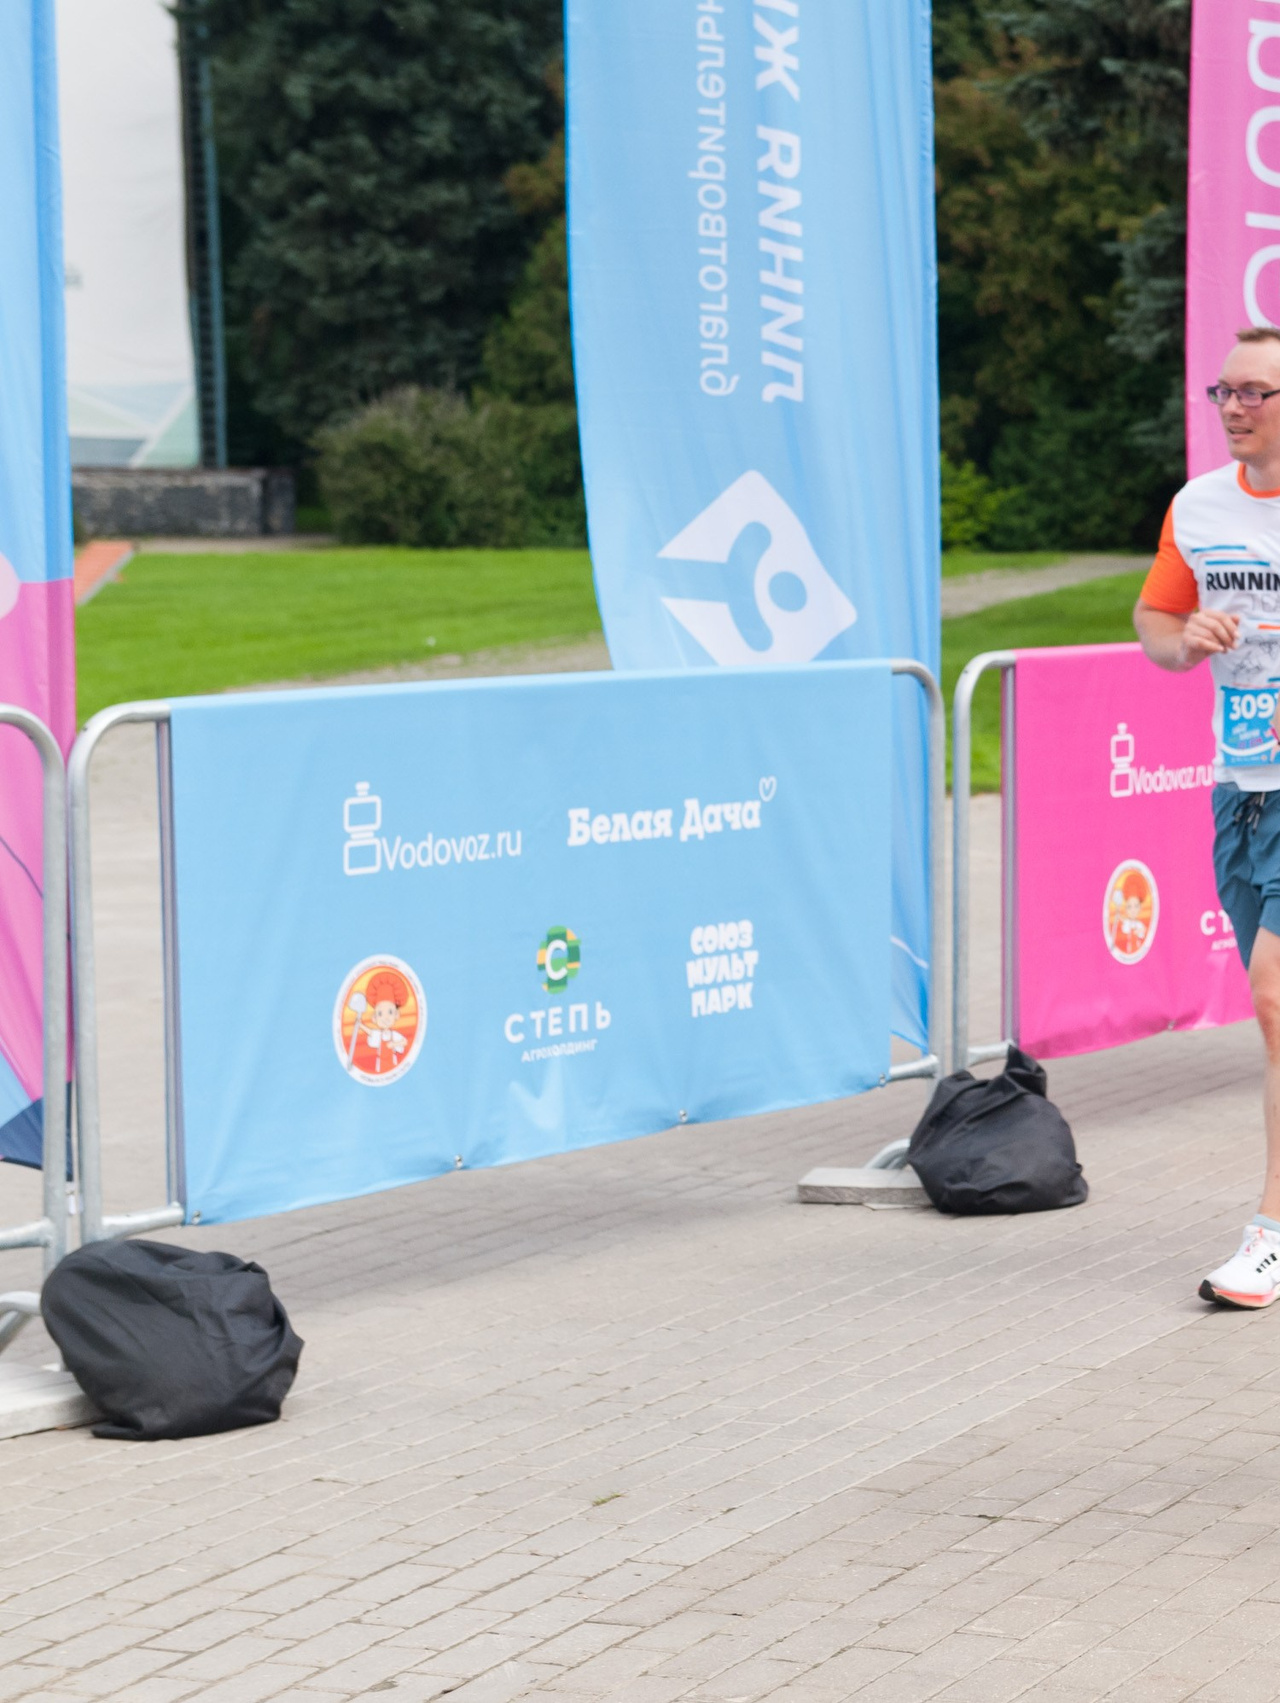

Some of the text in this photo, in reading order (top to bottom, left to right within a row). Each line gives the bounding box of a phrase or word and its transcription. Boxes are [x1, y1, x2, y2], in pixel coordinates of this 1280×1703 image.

[1229, 690, 1279, 720] 309
[1130, 764, 1213, 795] Vodovoz.ru
[567, 797, 762, 847] Белая Дача
[381, 830, 522, 872] Vodovoz.ru
[690, 919, 754, 956] СОЮЗ
[686, 949, 759, 989] МУЛЬТ
[691, 980, 754, 1018] ПАРК
[504, 1001, 612, 1044] СТЕПЬ
